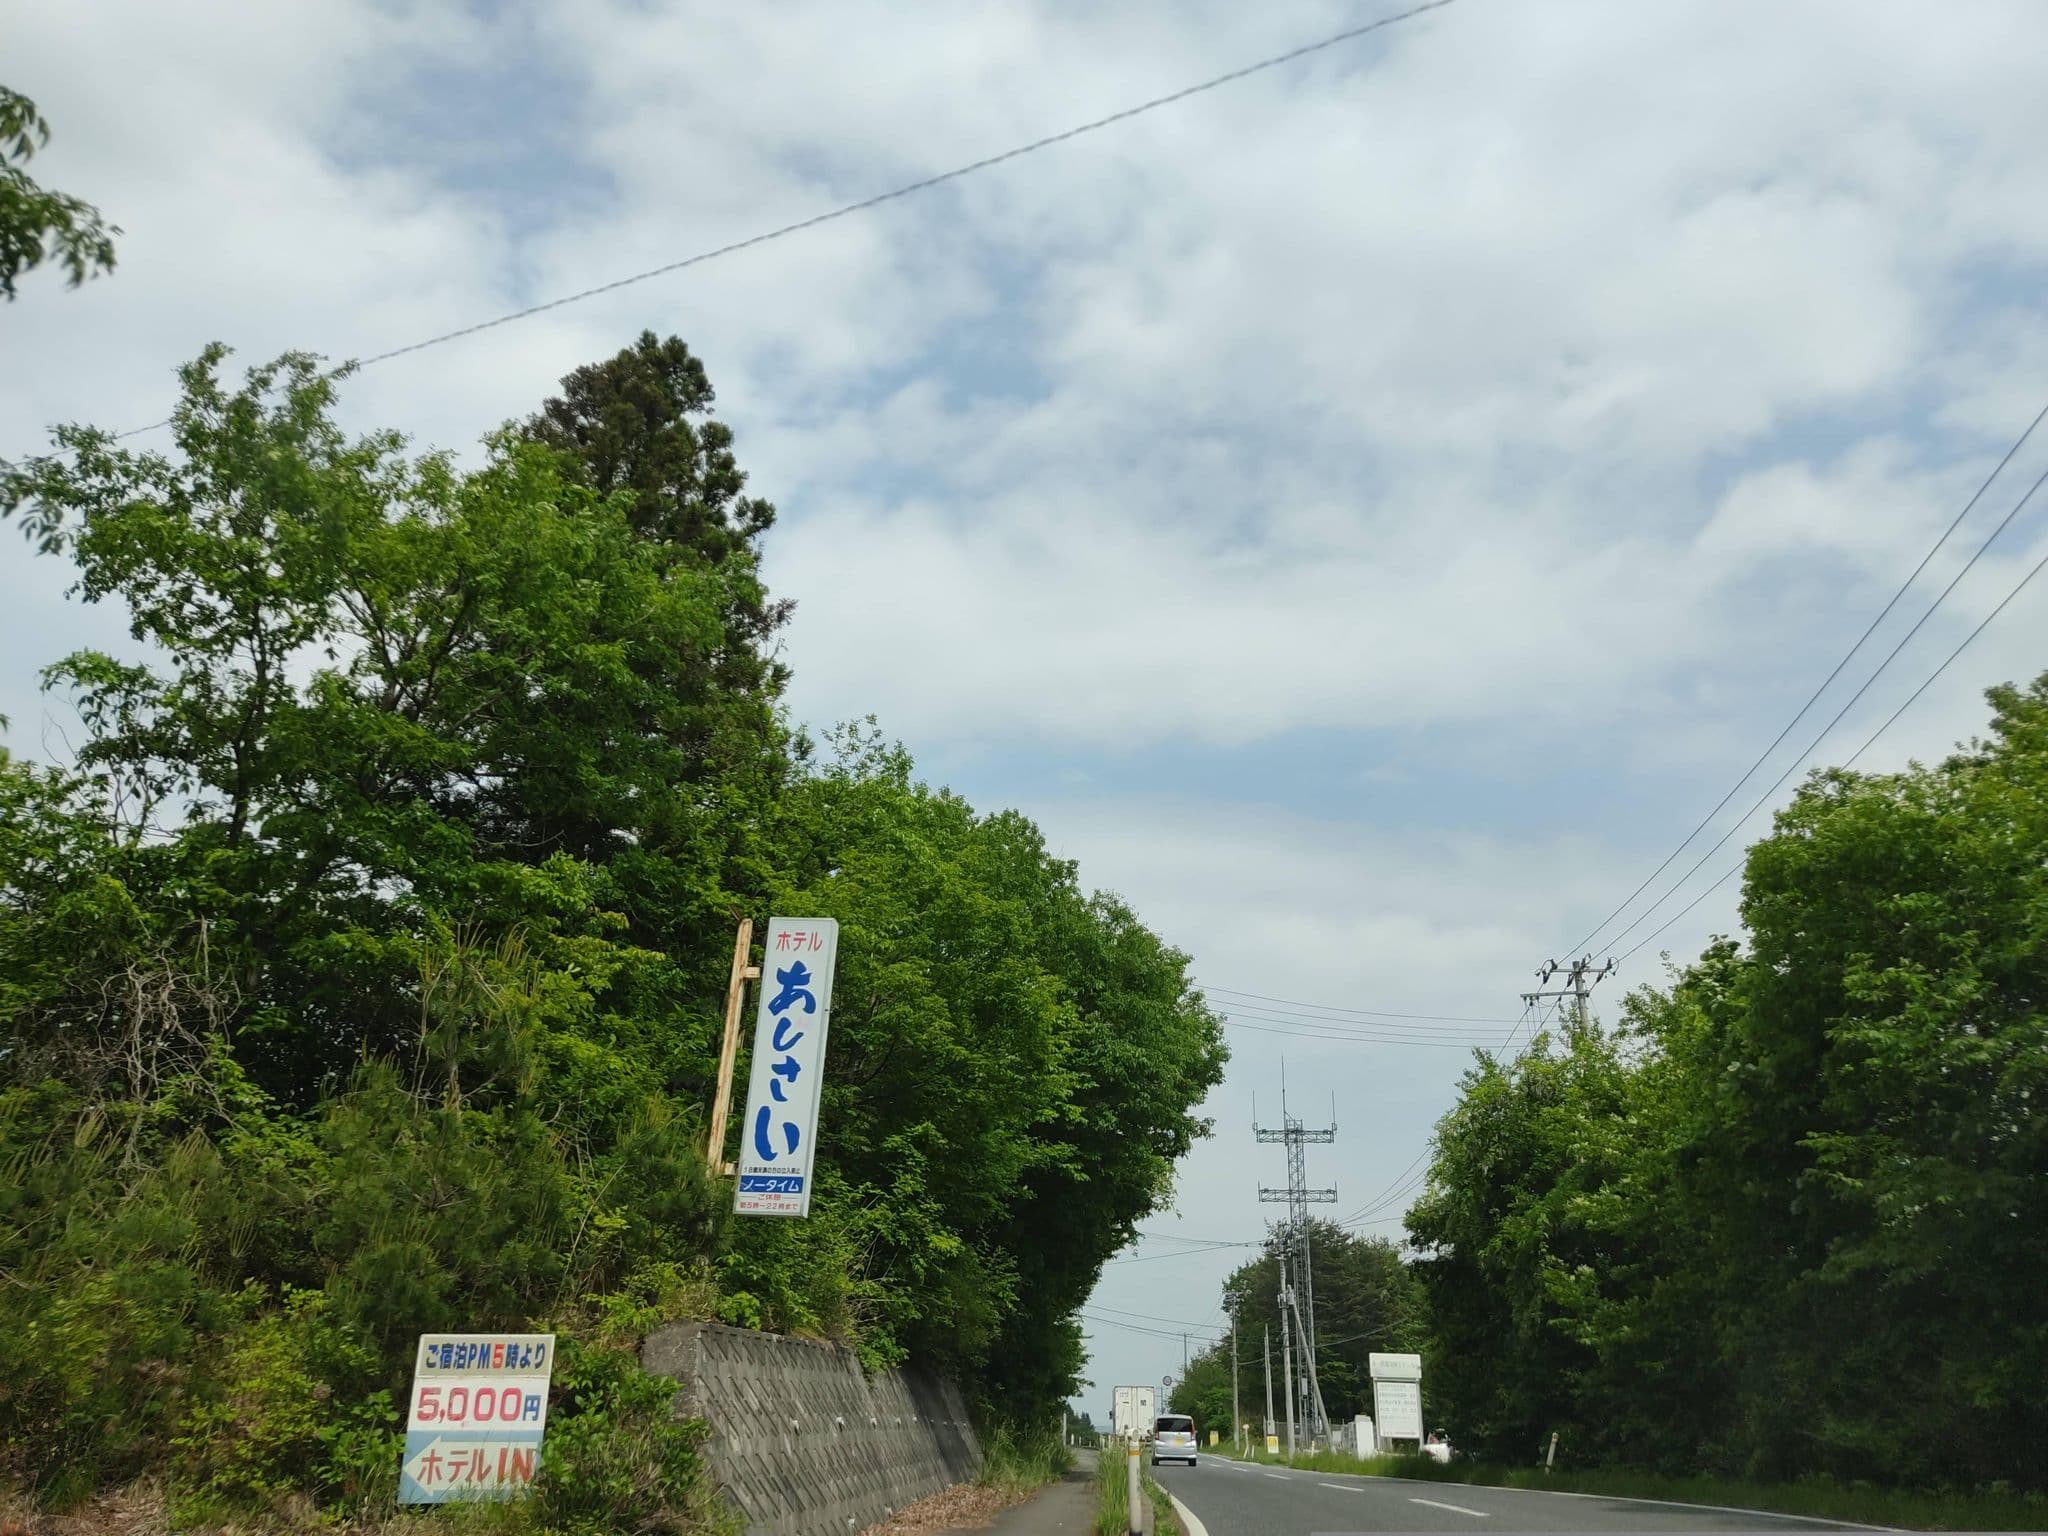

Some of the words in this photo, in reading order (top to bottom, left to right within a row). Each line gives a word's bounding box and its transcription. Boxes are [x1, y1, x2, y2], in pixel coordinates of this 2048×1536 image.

[776, 931, 823, 952] ホテル
[425, 1342, 546, 1370] ご宿泊PM5時より
[416, 1386, 542, 1423] 5,000円
